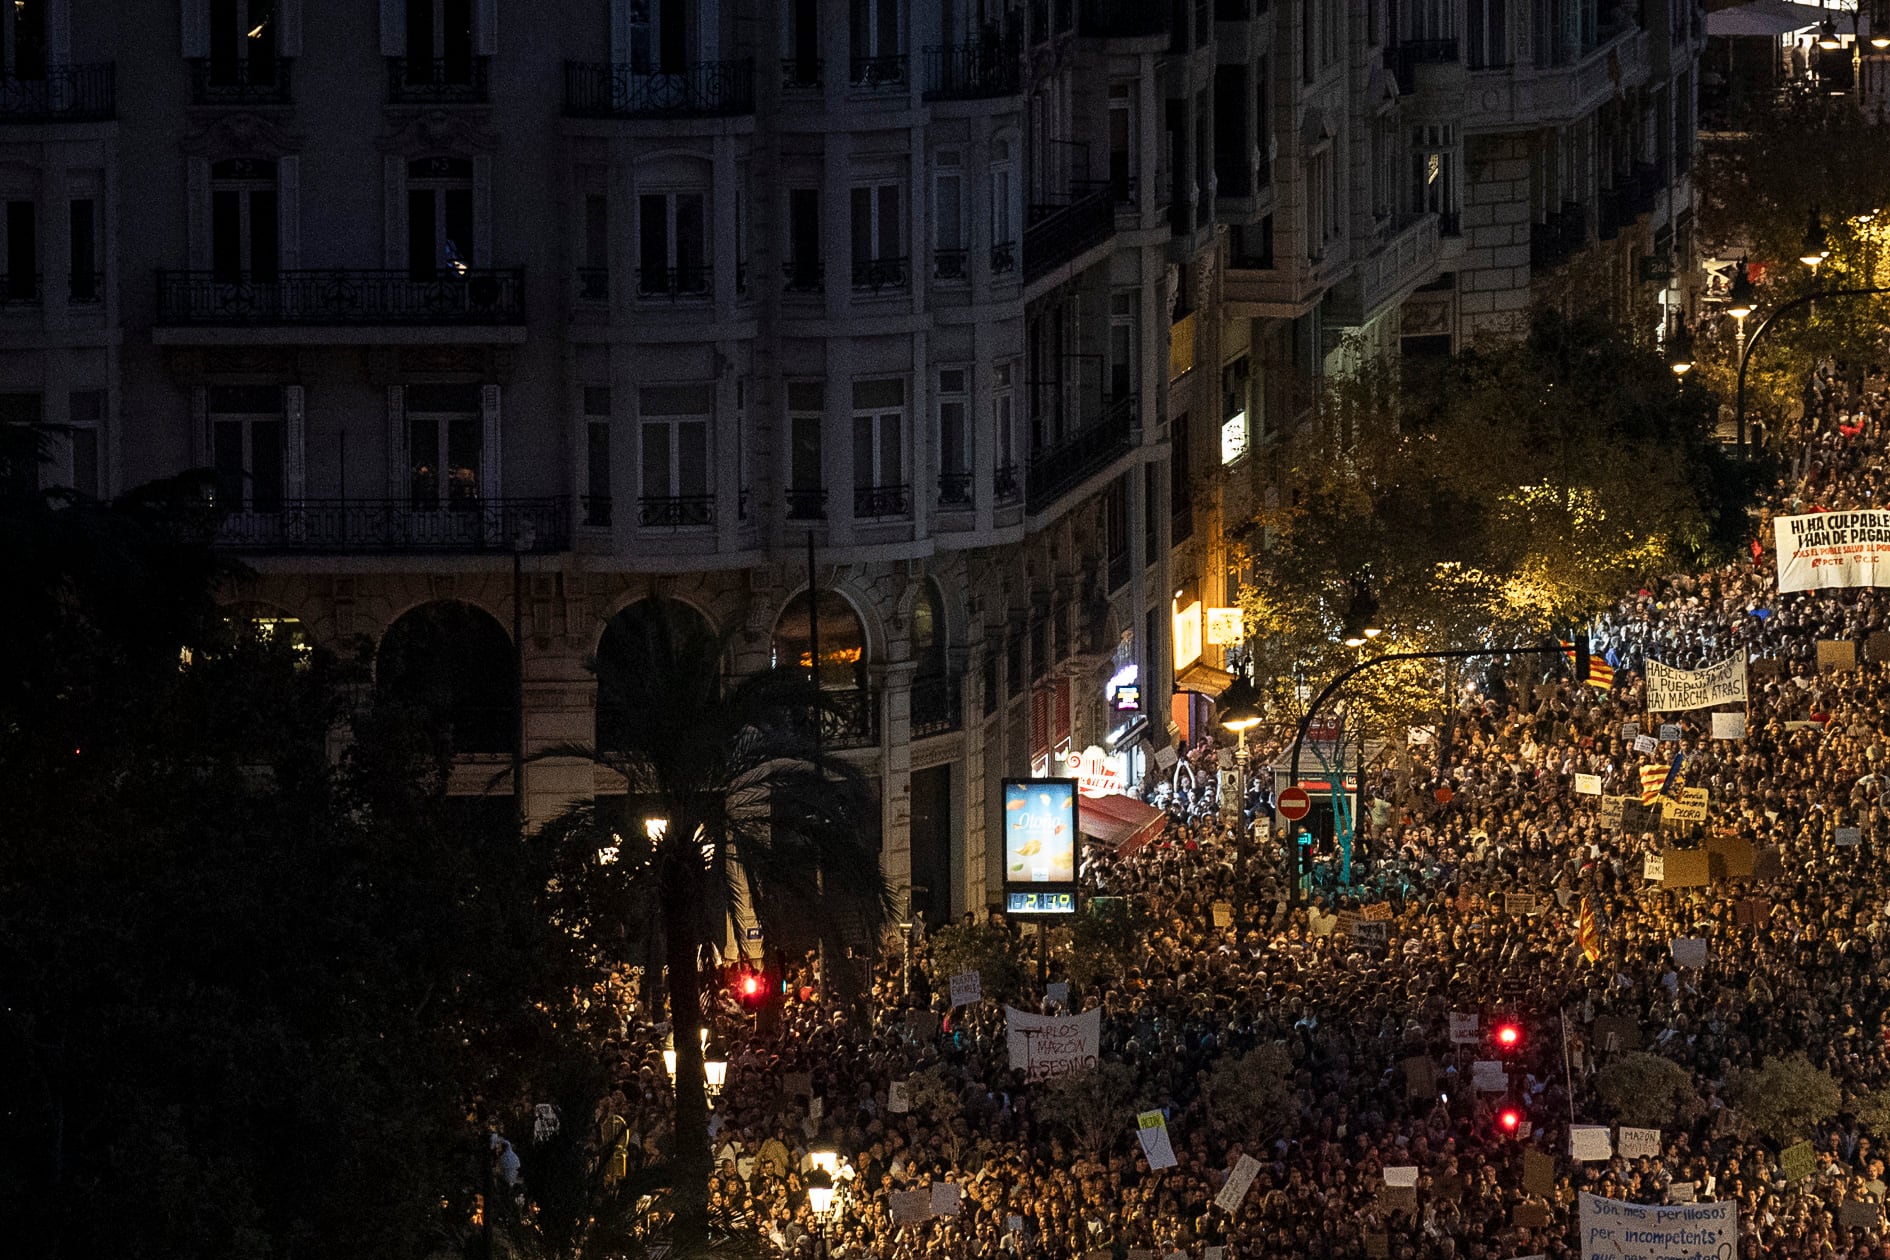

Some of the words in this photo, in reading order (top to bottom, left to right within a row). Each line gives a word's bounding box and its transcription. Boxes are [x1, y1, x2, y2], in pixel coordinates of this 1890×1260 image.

[1791, 520, 1804, 534] HI
[1807, 516, 1825, 532] HA
[1805, 531, 1830, 547] HAN
[1833, 530, 1848, 545] DE
[1648, 692, 1666, 709] HAY
[1669, 689, 1708, 708] MARCHA
[1593, 1201, 1618, 1215] Són
[1657, 1207, 1727, 1223] perillosos
[1591, 1227, 1615, 1244] per
[1625, 1229, 1716, 1249] incompetents
